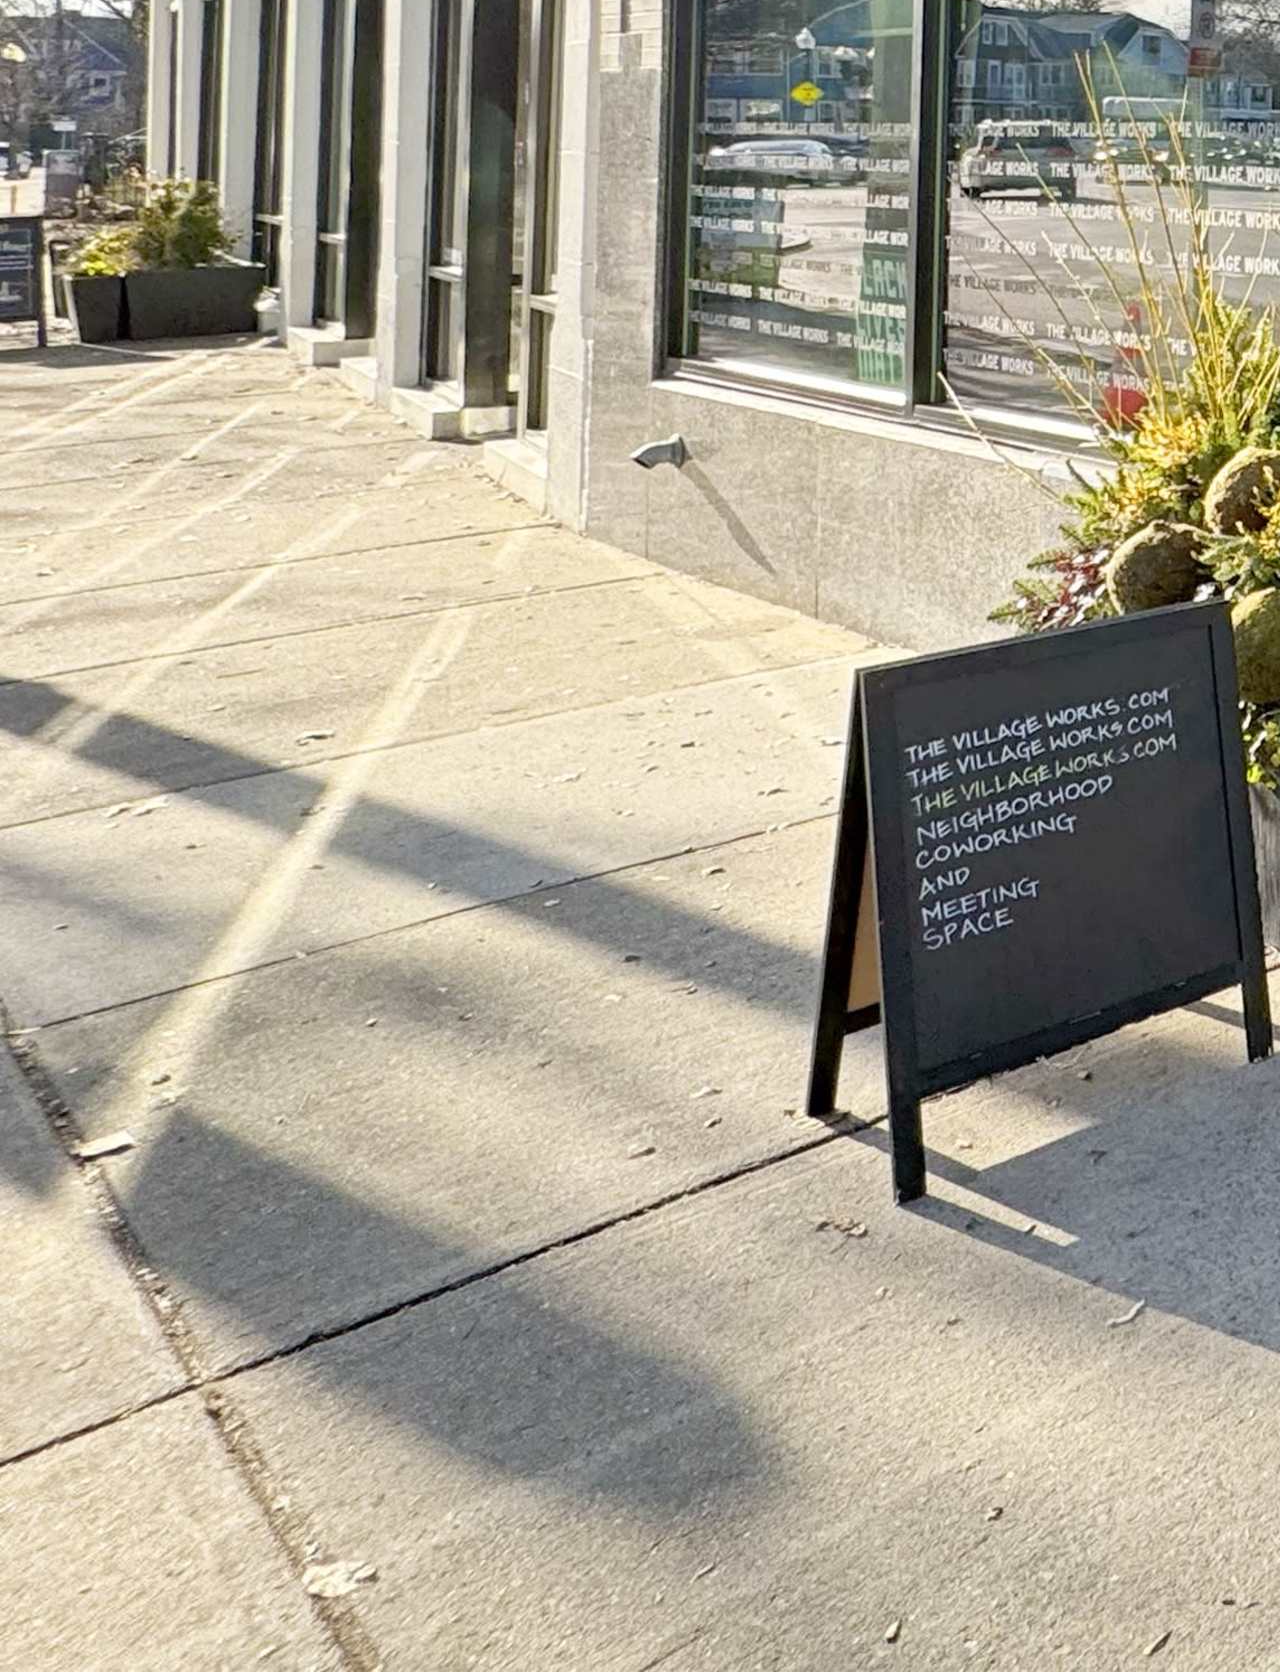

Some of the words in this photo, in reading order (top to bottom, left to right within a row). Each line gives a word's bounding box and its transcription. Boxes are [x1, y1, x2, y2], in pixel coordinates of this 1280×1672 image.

[1195, 121, 1244, 138] VILLAGE
[1194, 165, 1243, 183] VILLAGE
[1194, 208, 1242, 227] VILLAGE
[1002, 357, 1034, 375] WORKS
[904, 738, 948, 764] THE
[952, 716, 1043, 751] VILLAGE
[905, 761, 954, 788] THE
[956, 739, 1046, 775] VILLAGE
[910, 788, 957, 816] THE
[960, 765, 1052, 801] VILLAGE
[916, 775, 1113, 845] NEIGHBORHOOD
[915, 812, 1077, 870] COWORKING
[919, 867, 970, 901] AND
[921, 878, 1039, 926] MEETING
[923, 908, 1014, 951] SPACE
